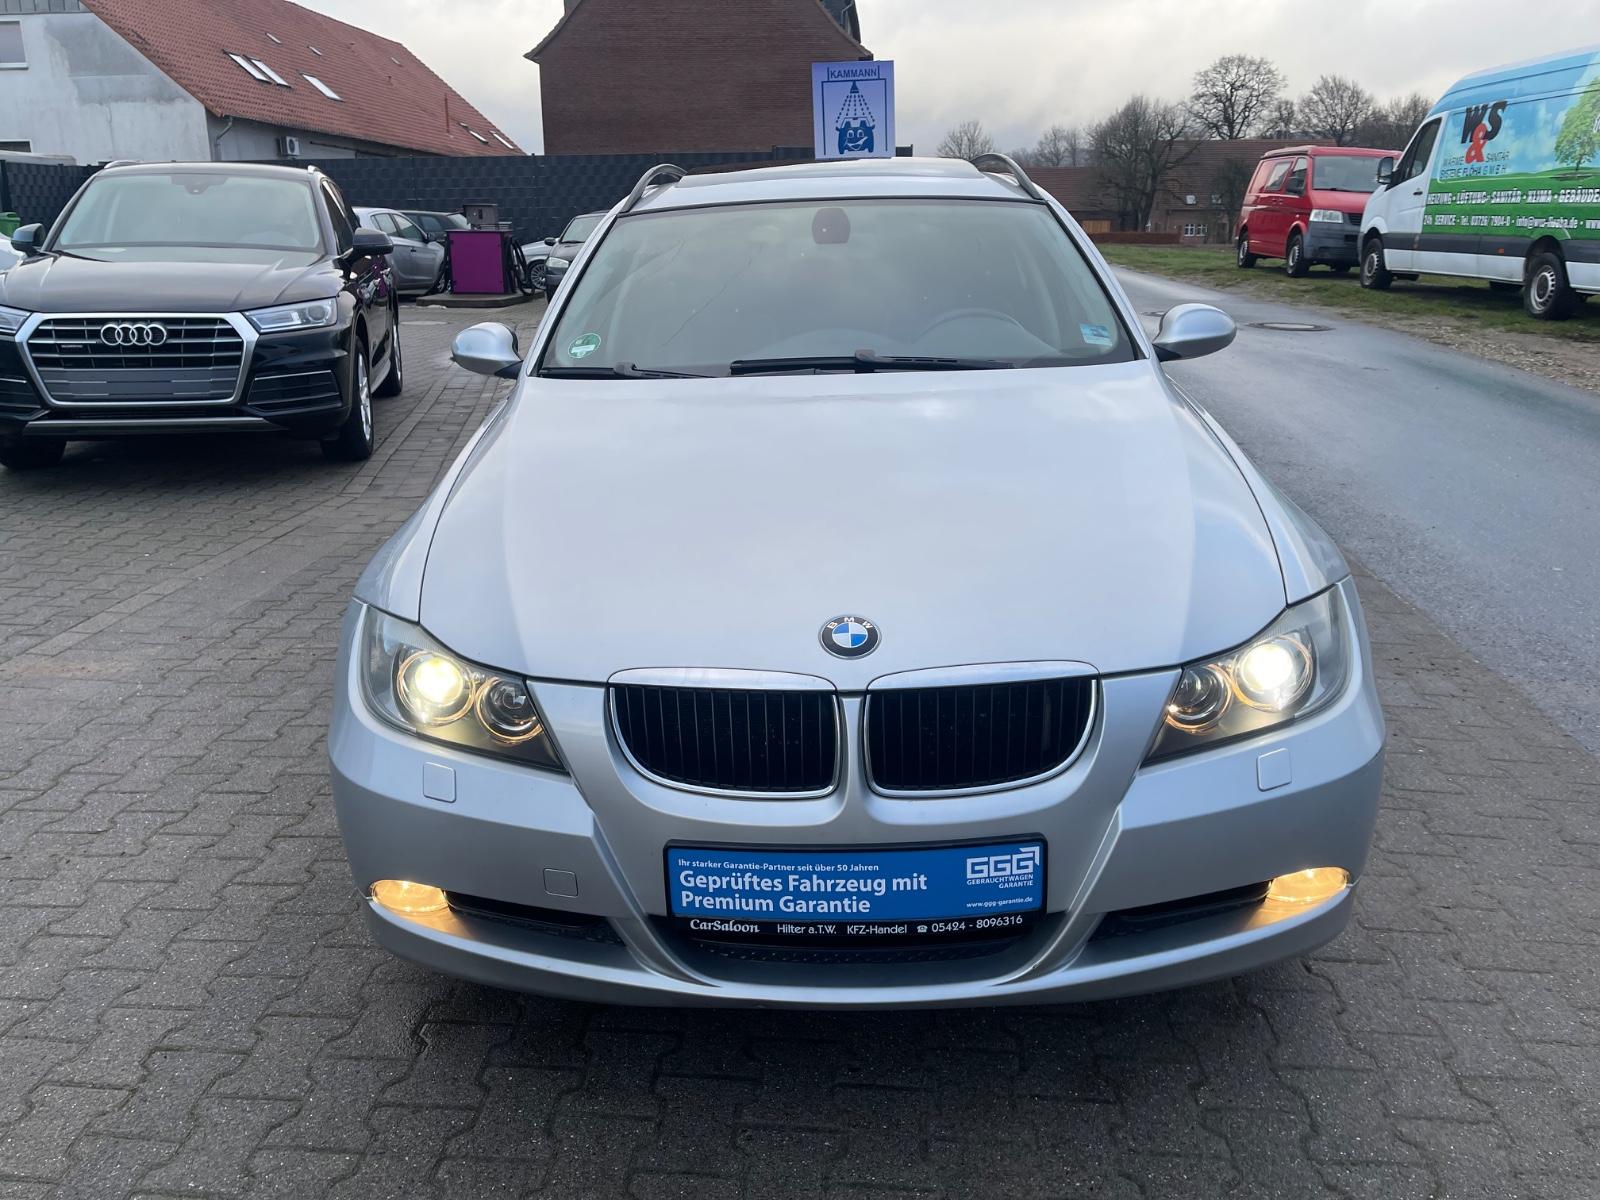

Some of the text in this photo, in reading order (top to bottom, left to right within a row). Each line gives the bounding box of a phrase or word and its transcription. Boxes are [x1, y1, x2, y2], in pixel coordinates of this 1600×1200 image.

[830, 68, 877, 78] KAMMANN
[1428, 193, 1453, 204] HEIZUNG
[1457, 190, 1487, 204] LÜFTUNG
[1491, 188, 1522, 204] SANITÄR
[1528, 190, 1552, 203] KLIMA
[1435, 215, 1457, 225] SERVICE
[678, 858, 690, 867] Ihr
[692, 860, 721, 869] starker
[723, 861, 795, 871] Garantie-Partner
[815, 863, 835, 871] über
[966, 852, 1034, 879] GGG
[679, 870, 928, 896] Geprüftes Fahrzeug mit
[966, 874, 1034, 886] GEBRAUCHTWAGEN
[998, 880, 1034, 889] GARANTIE
[681, 890, 870, 913] Premium Garantie
[966, 896, 1033, 908] www.ggg-garantie.de
[689, 919, 760, 933] CarSaloon
[777, 924, 806, 935] Hilter
[808, 924, 837, 935] a.T.W.
[847, 924, 907, 935] KFZ-Handel
[931, 921, 966, 933] 05424
[976, 915, 1023, 929] 8096316
